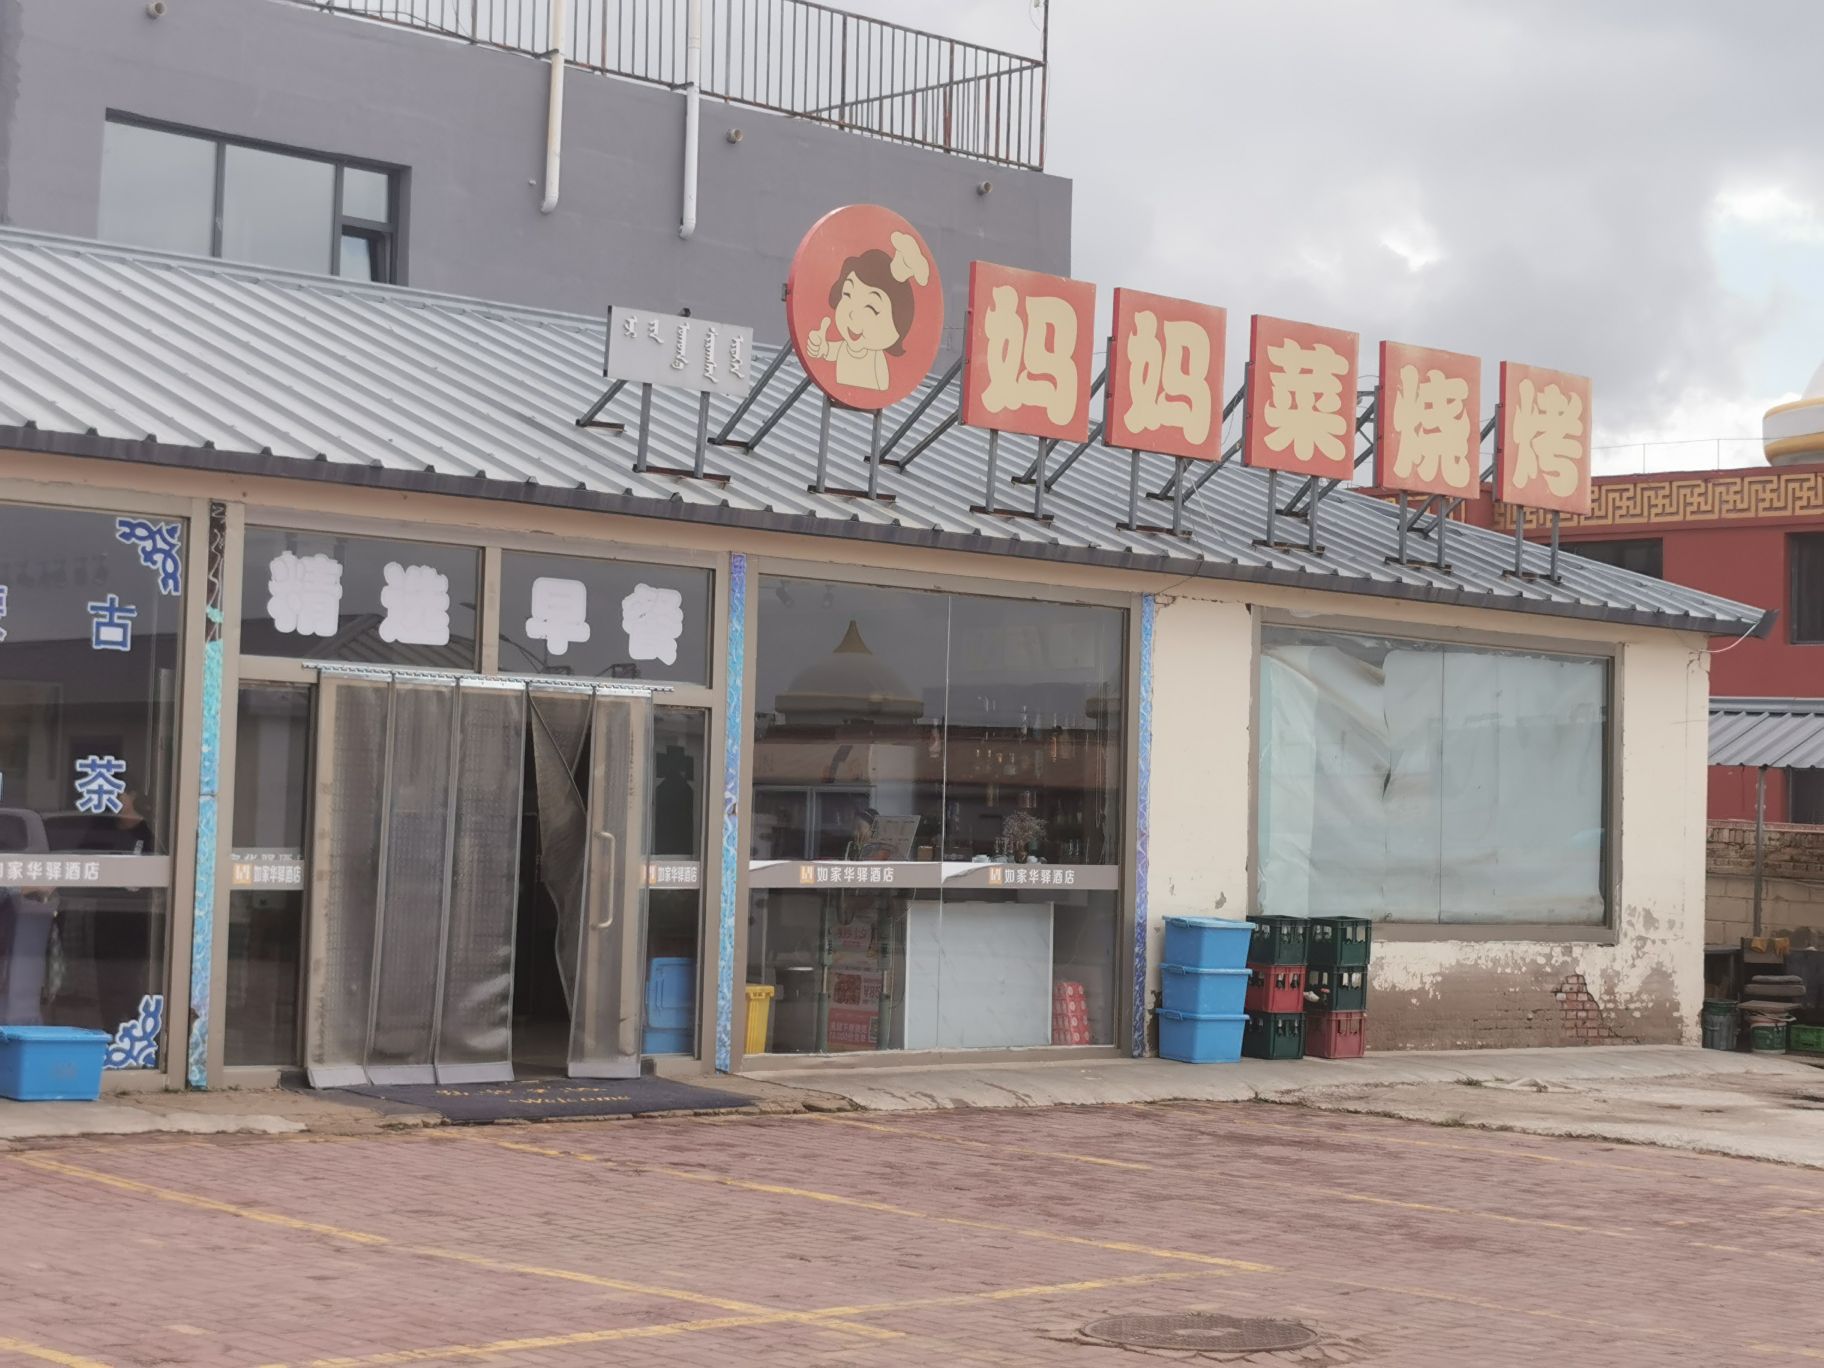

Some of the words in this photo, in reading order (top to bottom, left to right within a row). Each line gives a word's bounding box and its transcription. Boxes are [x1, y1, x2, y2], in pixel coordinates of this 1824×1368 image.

[981, 286, 1584, 497] 妈妈菜烧烤
[88, 594, 137, 651] 古
[75, 755, 126, 813] 茶
[0, 861, 99, 880] 家华驿酒店
[817, 867, 894, 882] 如家华驿酒店
[1004, 869, 1075, 884] 如家华驿酒店
